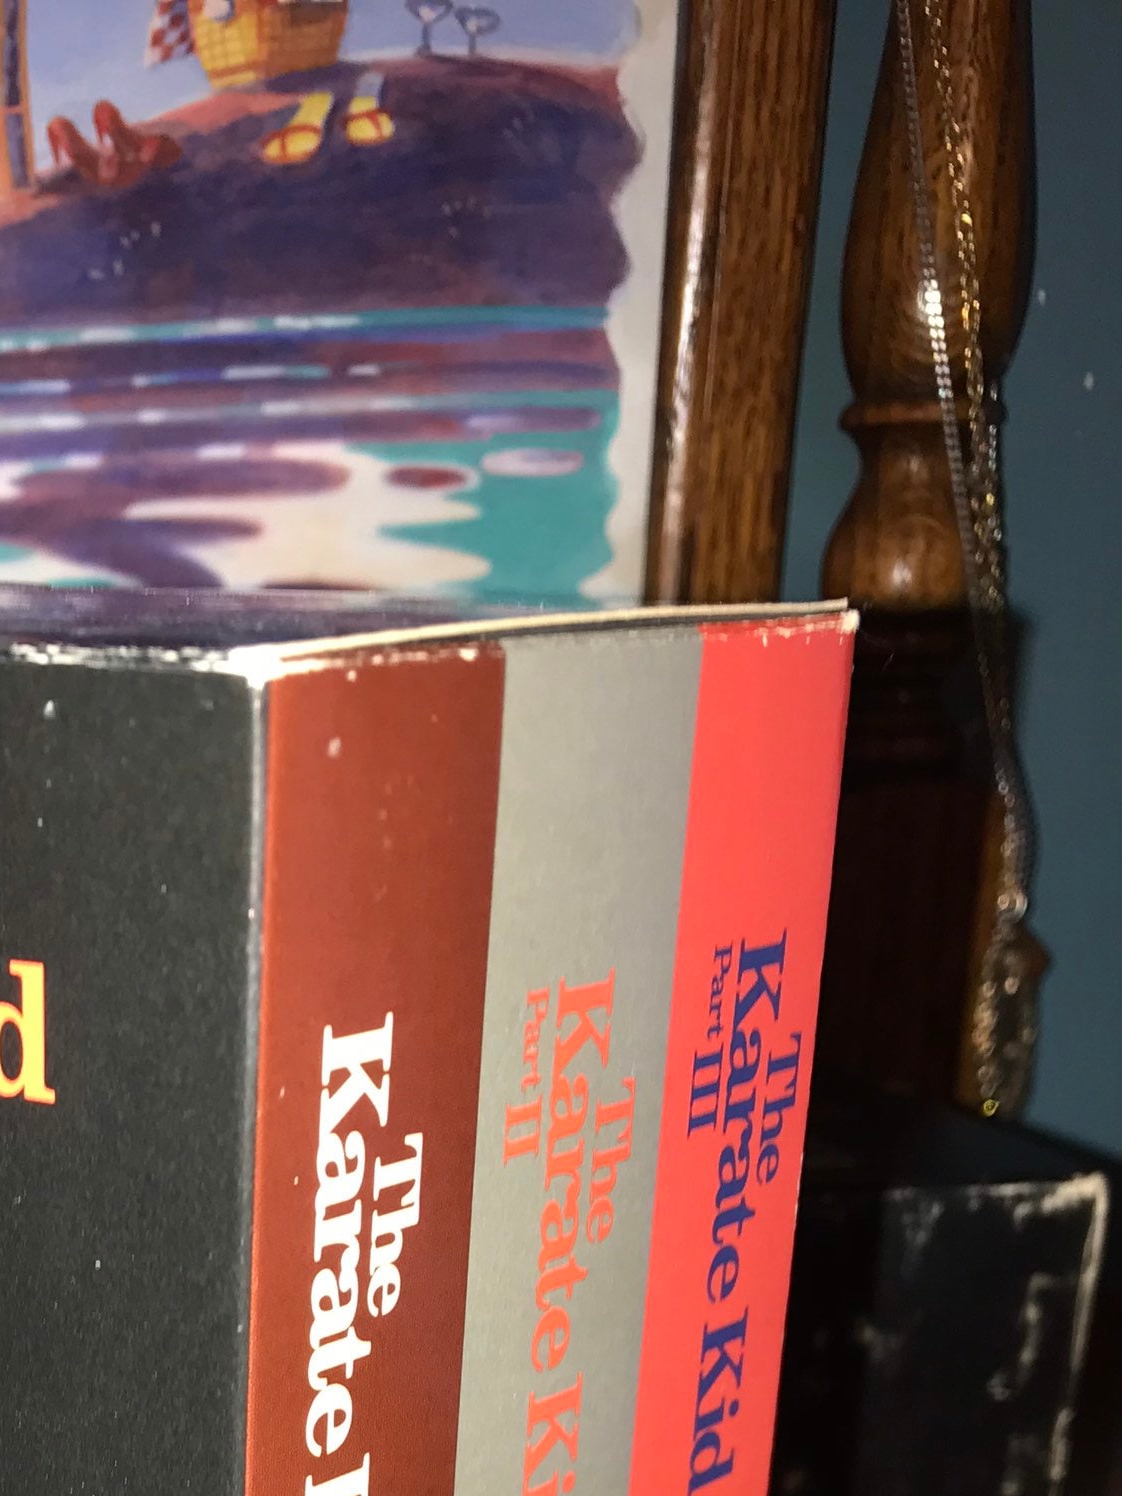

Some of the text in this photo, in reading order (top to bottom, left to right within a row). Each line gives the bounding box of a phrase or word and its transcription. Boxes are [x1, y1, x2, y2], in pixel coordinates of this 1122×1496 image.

[503, 987, 551, 1166] Part II
[687, 944, 733, 1140] Part III
[706, 927, 788, 1304] Karate
[756, 1030, 803, 1187] The
[305, 1011, 394, 1458] Karate
[367, 1131, 424, 1317] The
[530, 966, 616, 1374] Karate
[585, 1077, 637, 1245] The
